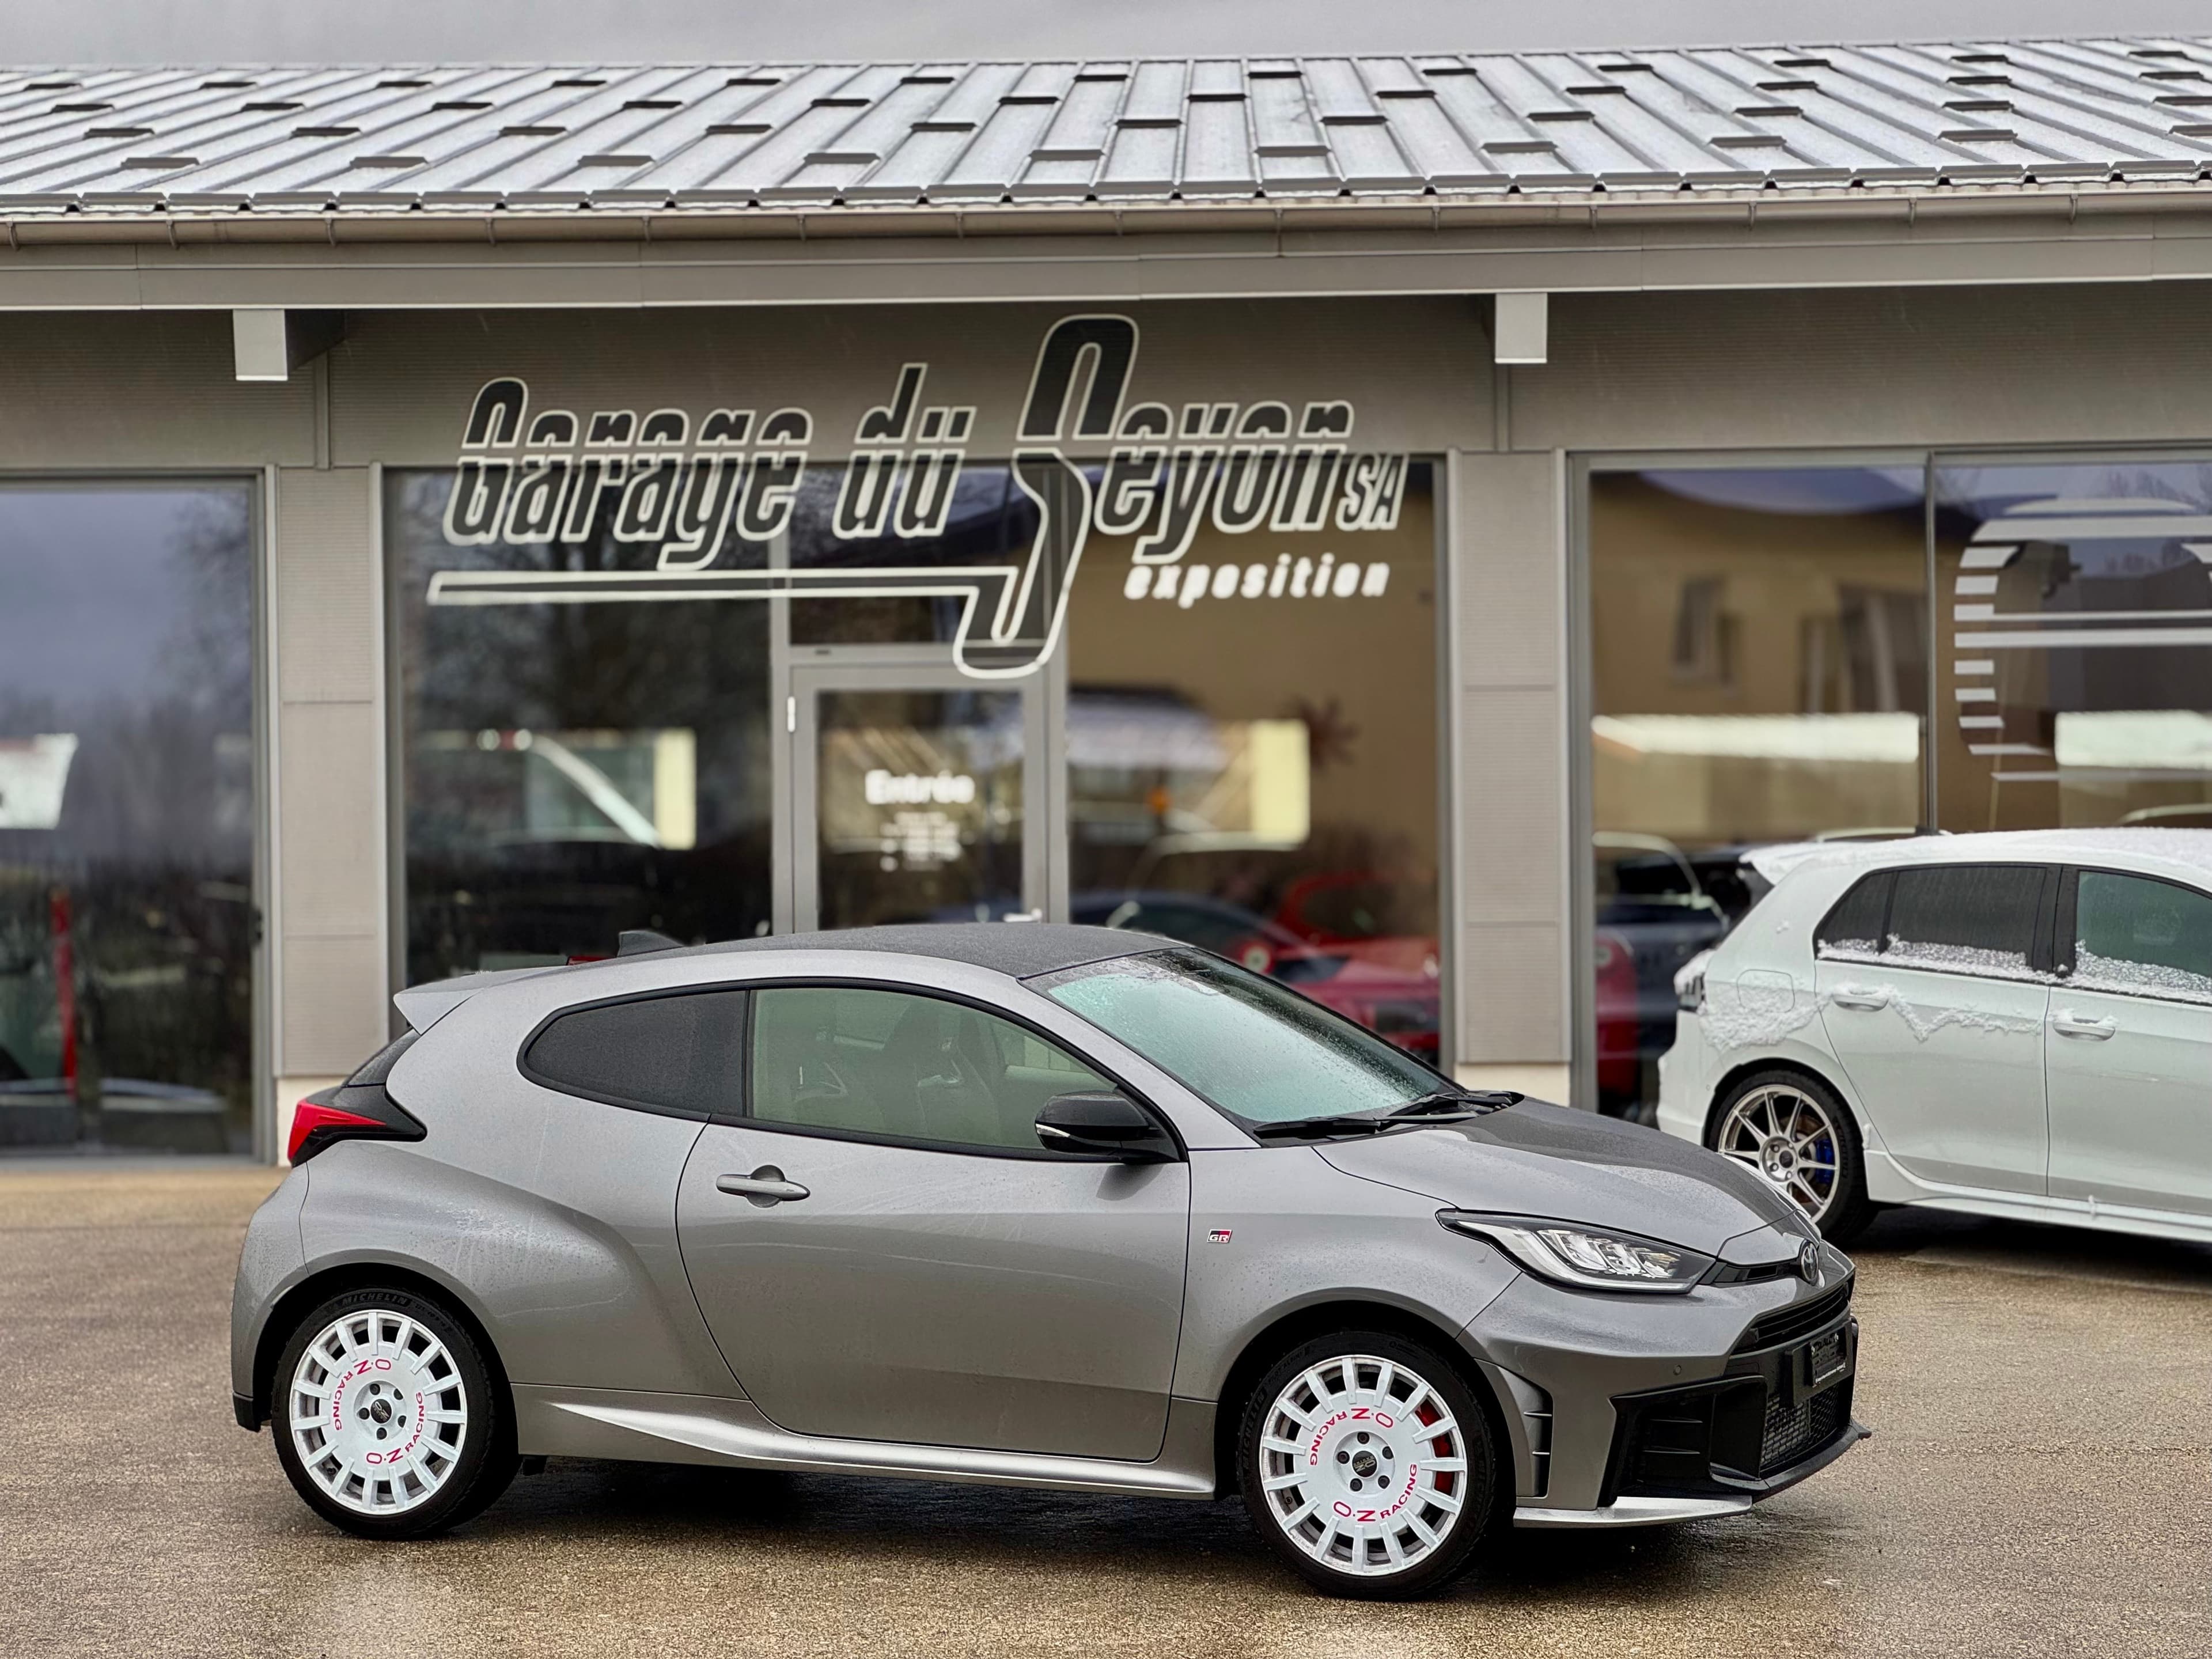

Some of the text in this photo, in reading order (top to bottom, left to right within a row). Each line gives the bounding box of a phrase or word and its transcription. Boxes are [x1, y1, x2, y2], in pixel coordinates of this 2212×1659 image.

[442, 314, 1410, 679] Garage du Seyon SA
[1124, 552, 1390, 609] exposition
[333, 1371, 353, 1431] RACING
[405, 1392, 425, 1453] RACING
[1310, 1411, 1348, 1466] RACING
[1380, 1464, 1418, 1520] RACING
